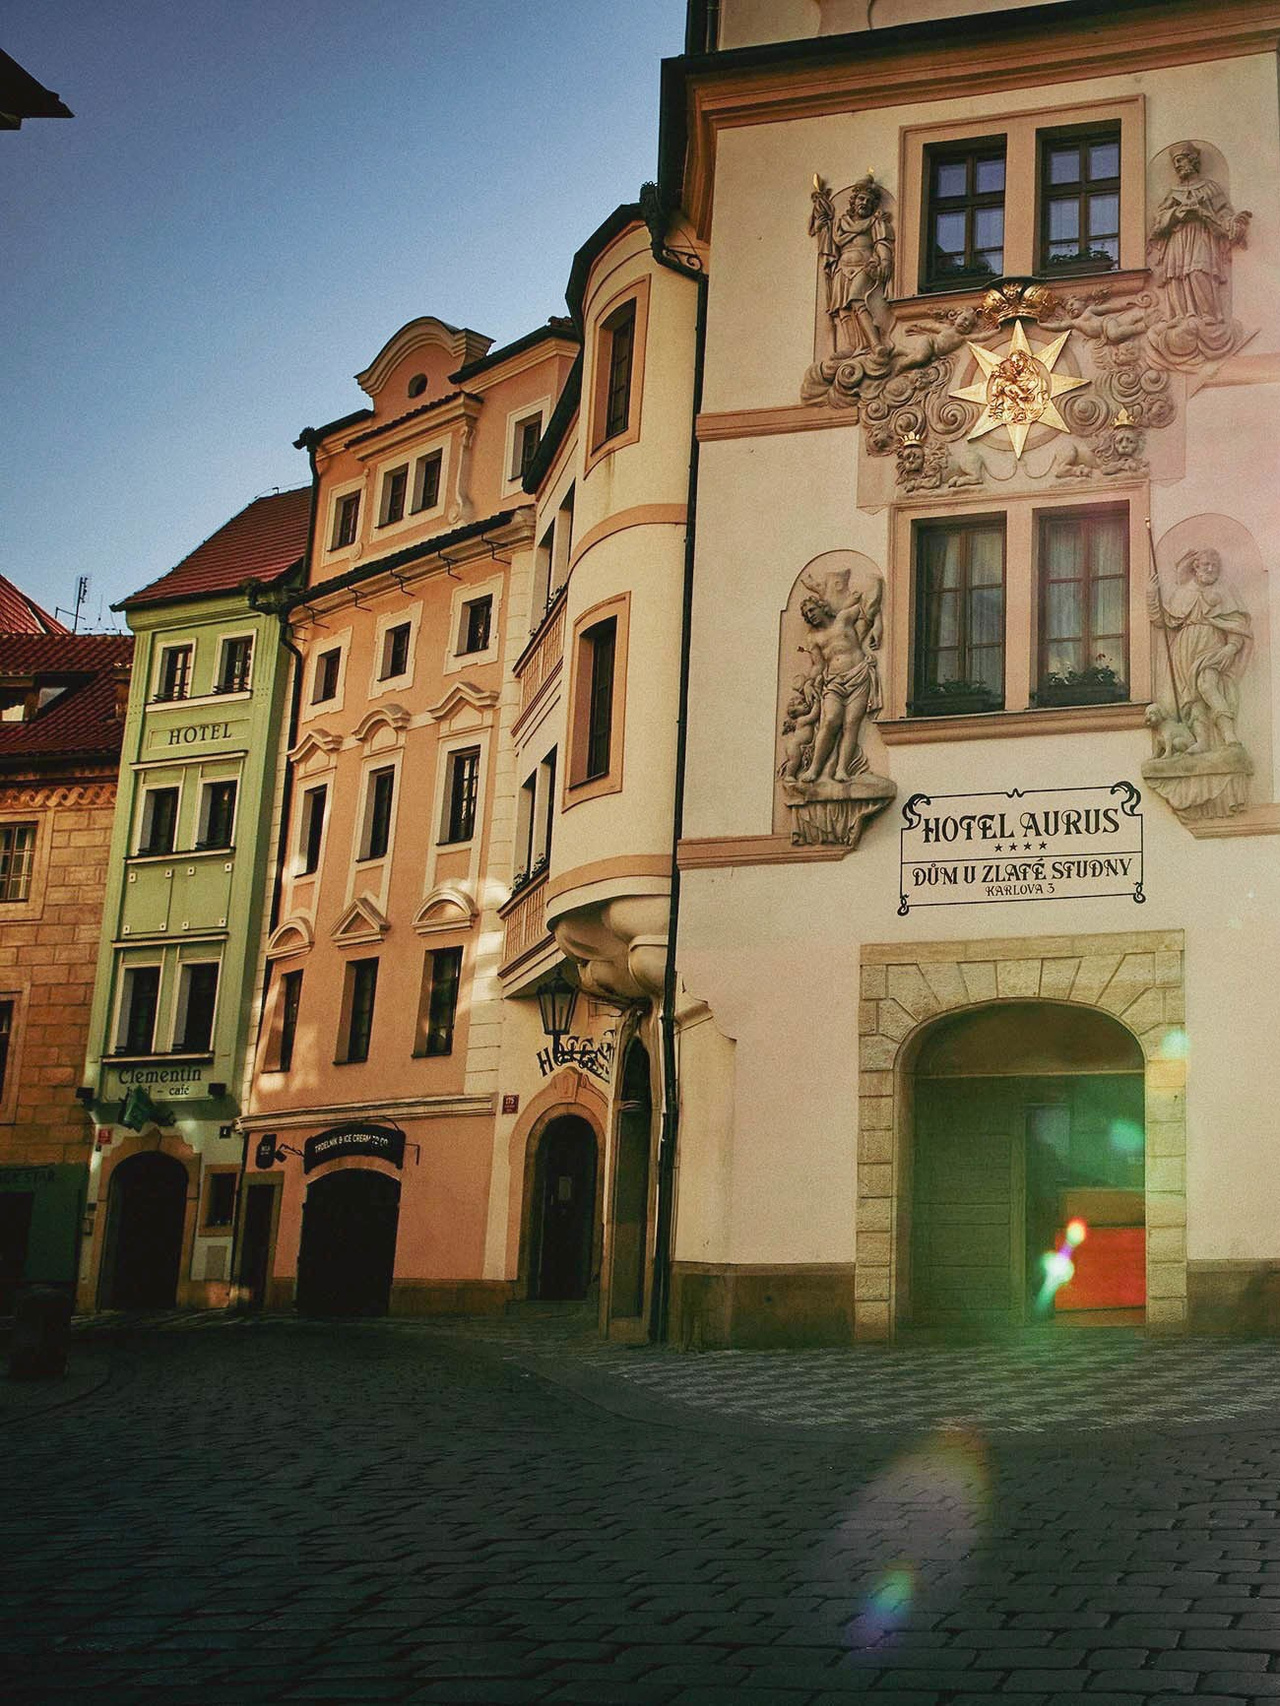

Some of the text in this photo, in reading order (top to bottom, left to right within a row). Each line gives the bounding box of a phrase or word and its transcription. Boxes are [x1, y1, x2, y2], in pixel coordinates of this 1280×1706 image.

[168, 723, 232, 745] HOTEL
[921, 807, 1121, 844] HOTEL AURUS
[911, 857, 1133, 886] DŮM U ZLATÉ STUDNY
[985, 882, 1055, 897] KARLOVA 3
[118, 1068, 202, 1085] Clementin
